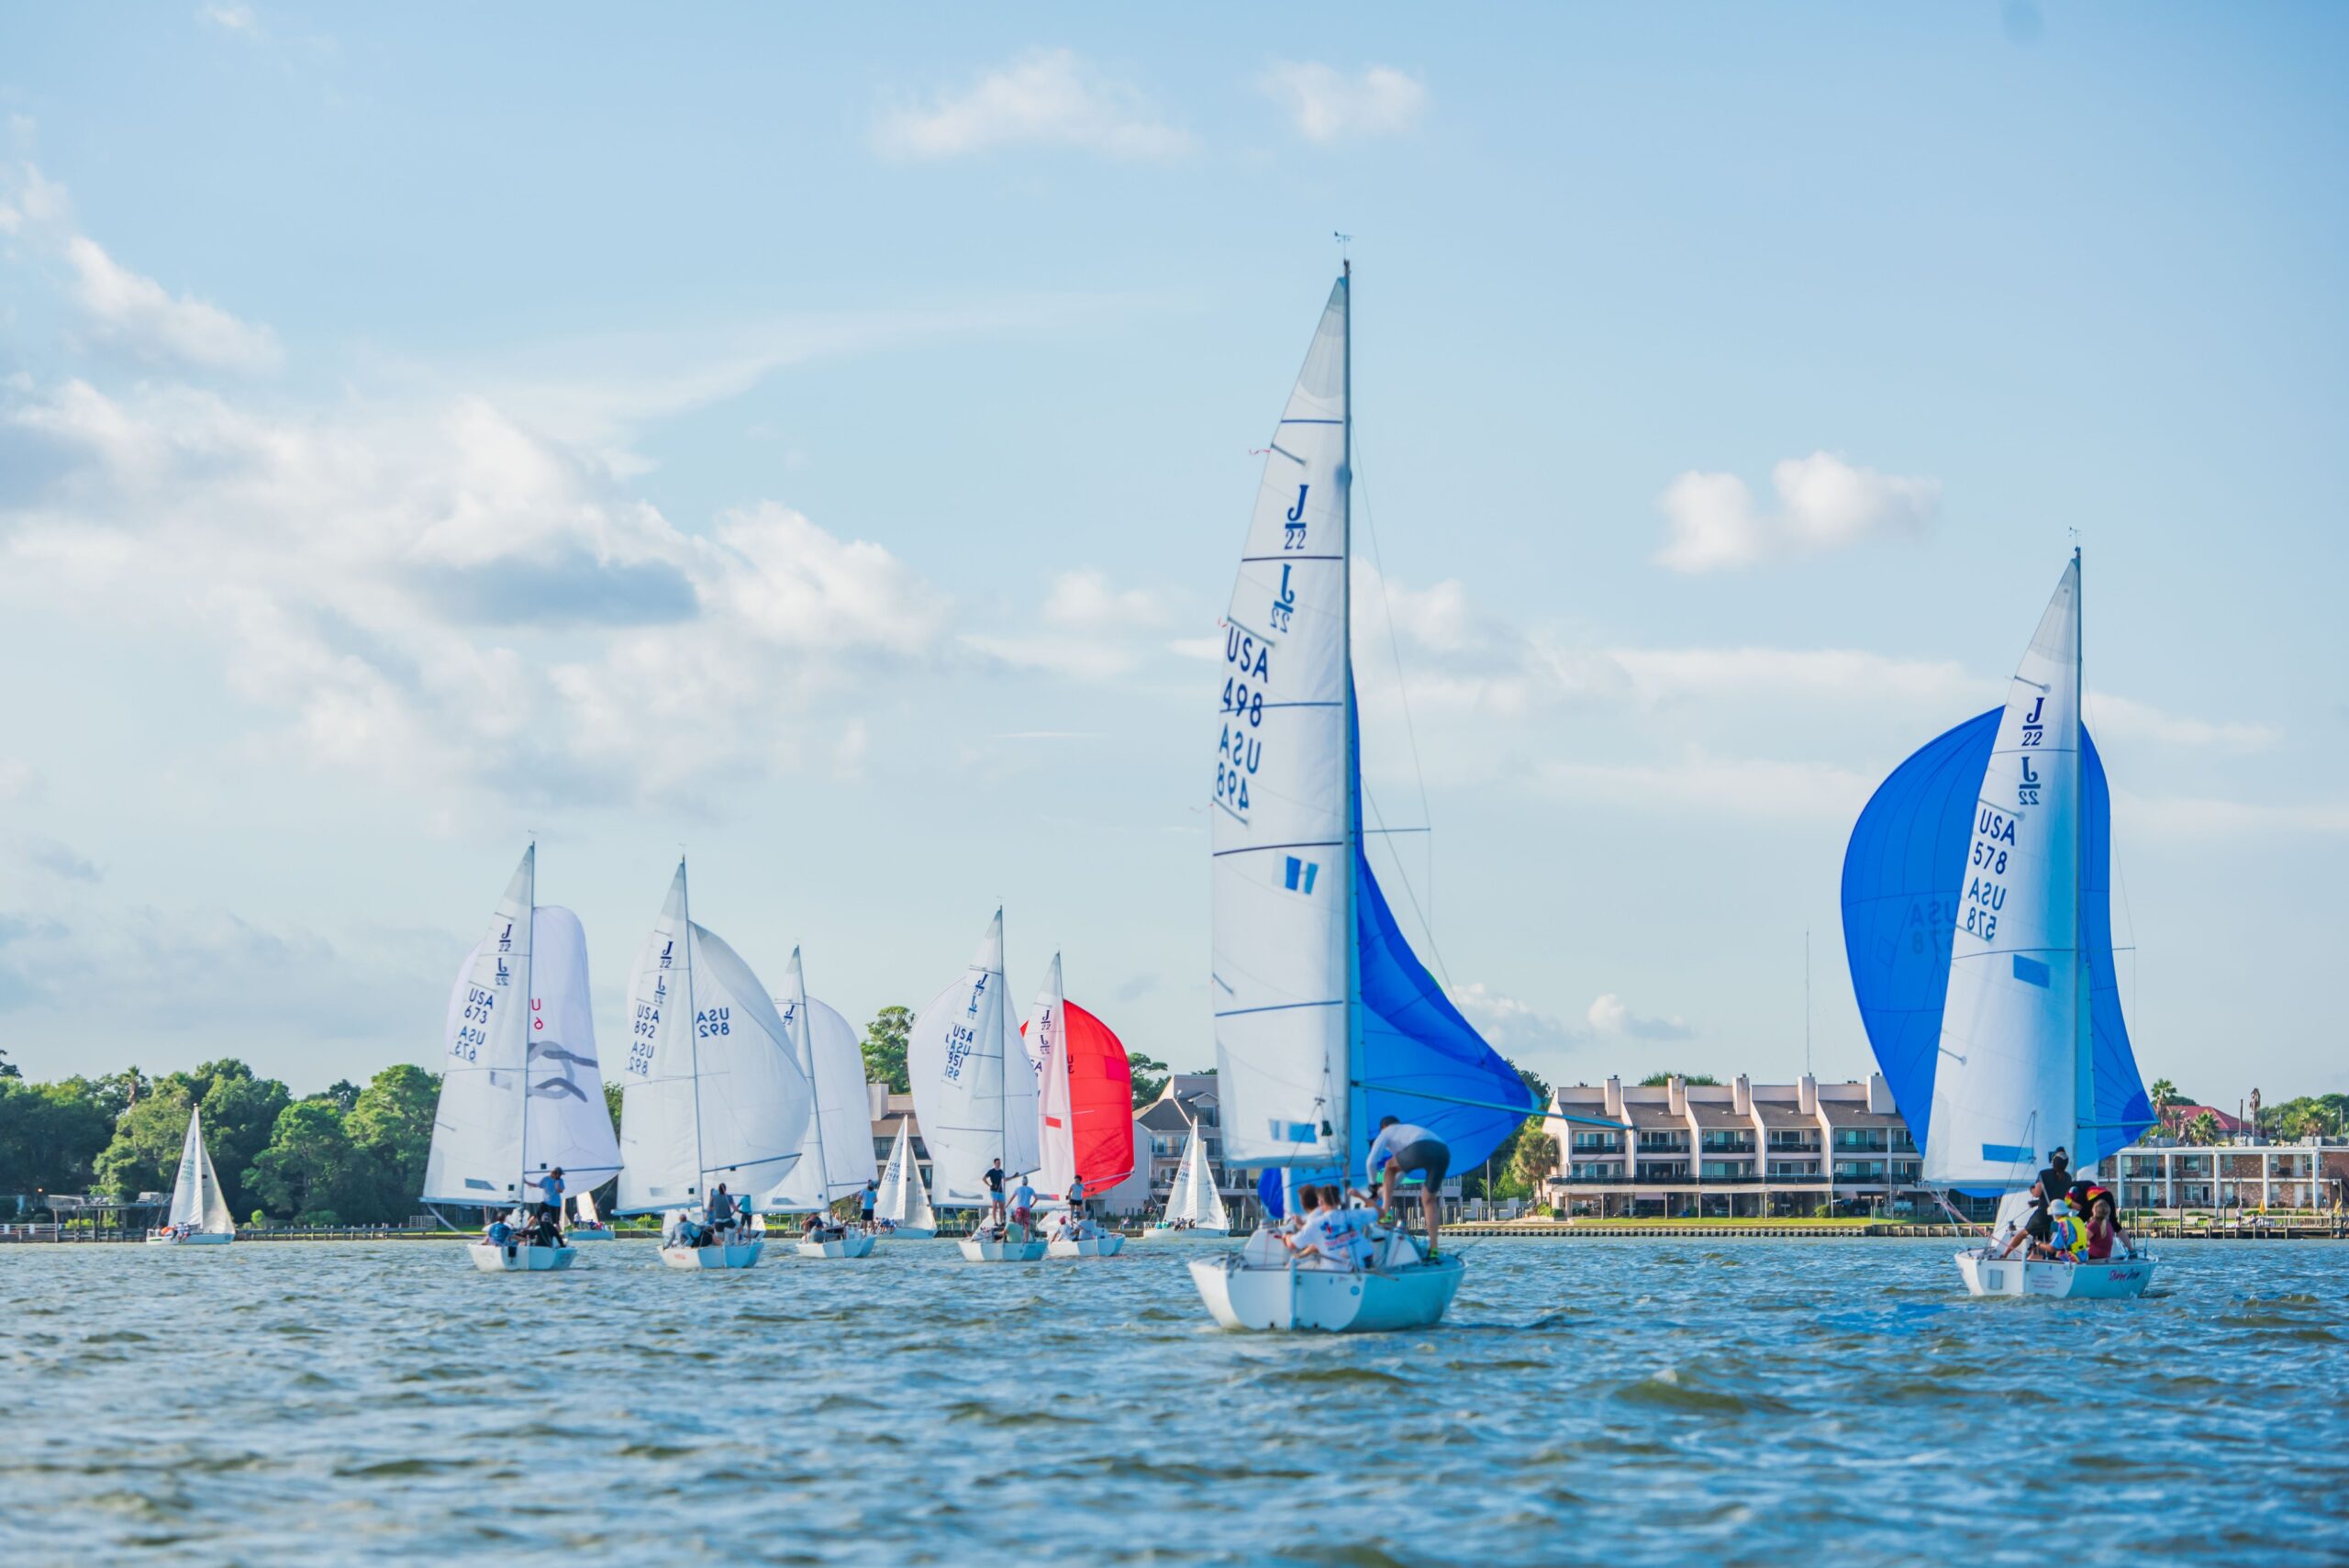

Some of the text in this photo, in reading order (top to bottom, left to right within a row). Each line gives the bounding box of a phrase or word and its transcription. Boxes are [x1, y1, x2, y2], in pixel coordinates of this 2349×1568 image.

[1287, 484, 1309, 520] J
[1284, 528, 1307, 550] 22
[1227, 626, 1269, 684] USA
[1222, 676, 1264, 728] 498
[2026, 696, 2045, 724] J
[2021, 731, 2043, 747] 22
[1979, 808, 2016, 846] USA
[1973, 841, 2008, 875] 578
[501, 924, 513, 939] J
[498, 943, 511, 952] 22
[662, 940, 674, 956] J
[659, 960, 672, 969] 22
[977, 973, 988, 985] J
[468, 988, 494, 1010] USA
[464, 1006, 488, 1024] 673
[637, 1004, 660, 1024] USA
[785, 1005, 796, 1016] J
[1041, 1010, 1051, 1021] J
[634, 1020, 656, 1039] 892
[952, 1025, 974, 1043] USA
[948, 1051, 963, 1069] 951
